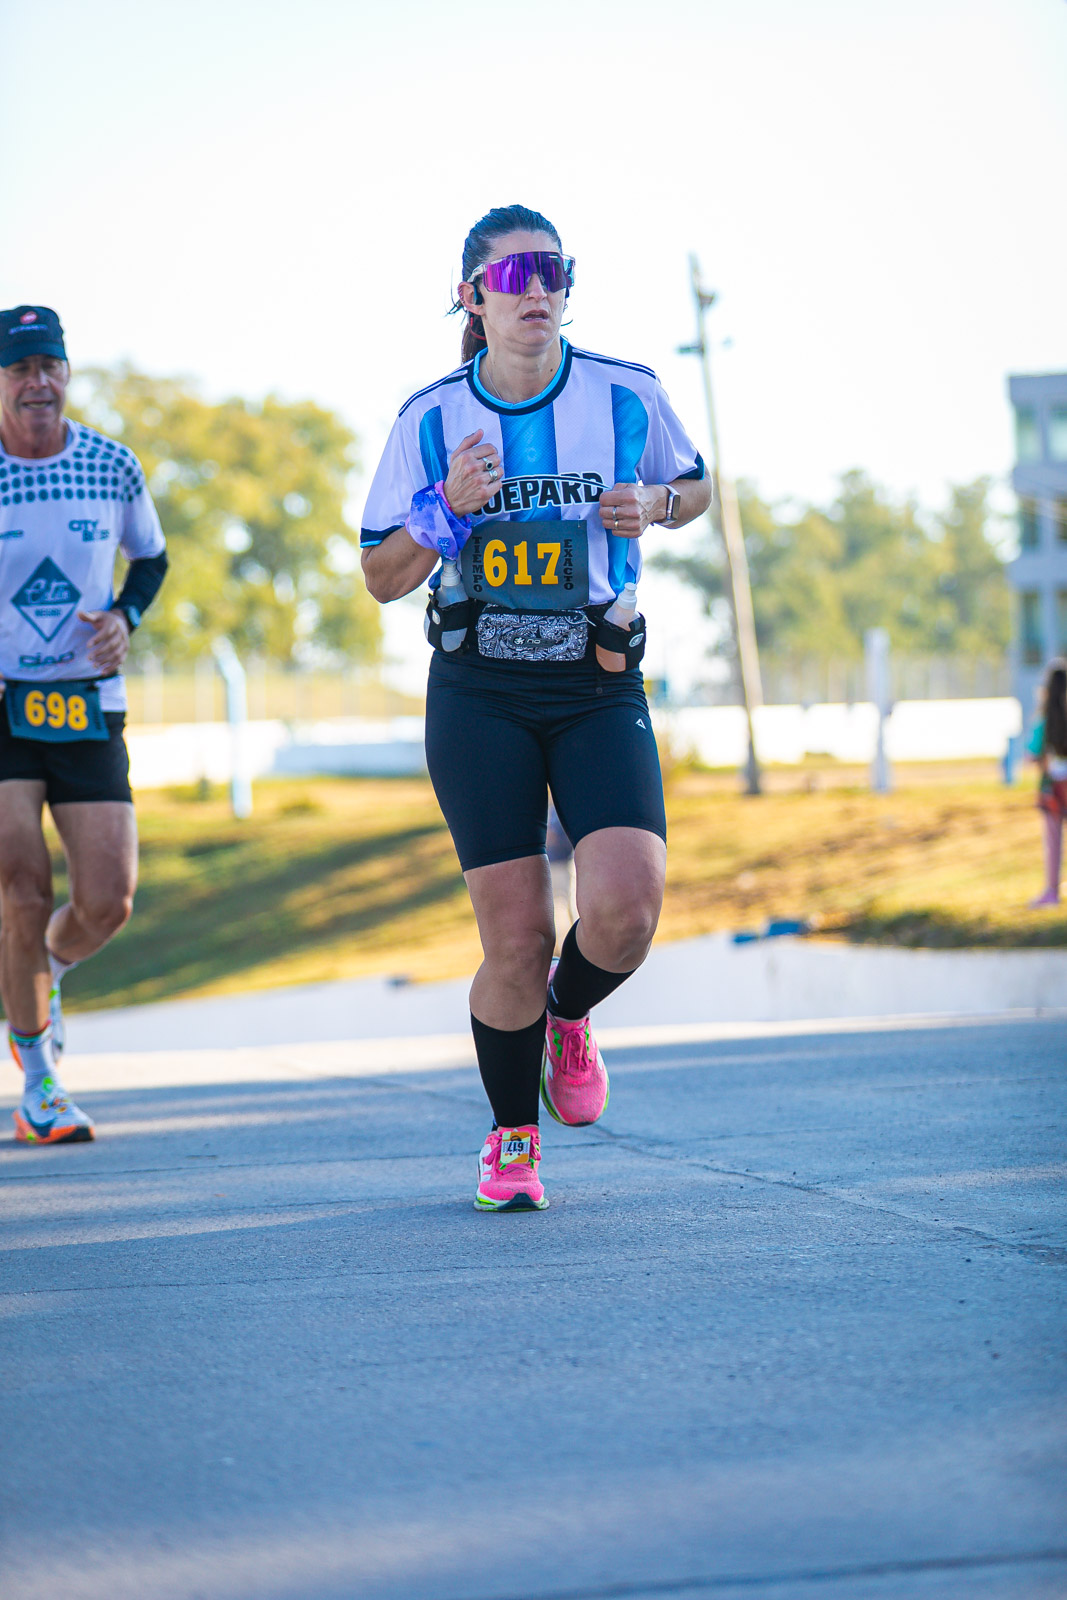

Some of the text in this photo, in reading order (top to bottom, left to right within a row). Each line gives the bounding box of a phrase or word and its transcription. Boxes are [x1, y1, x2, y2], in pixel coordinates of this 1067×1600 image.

[471, 472, 603, 516] UEPARD
[472, 536, 483, 593] TIEMPO
[483, 539, 561, 587] 617
[563, 538, 574, 590] EXACTO
[24, 690, 89, 731] 698
[508, 1141, 524, 1152] 617
